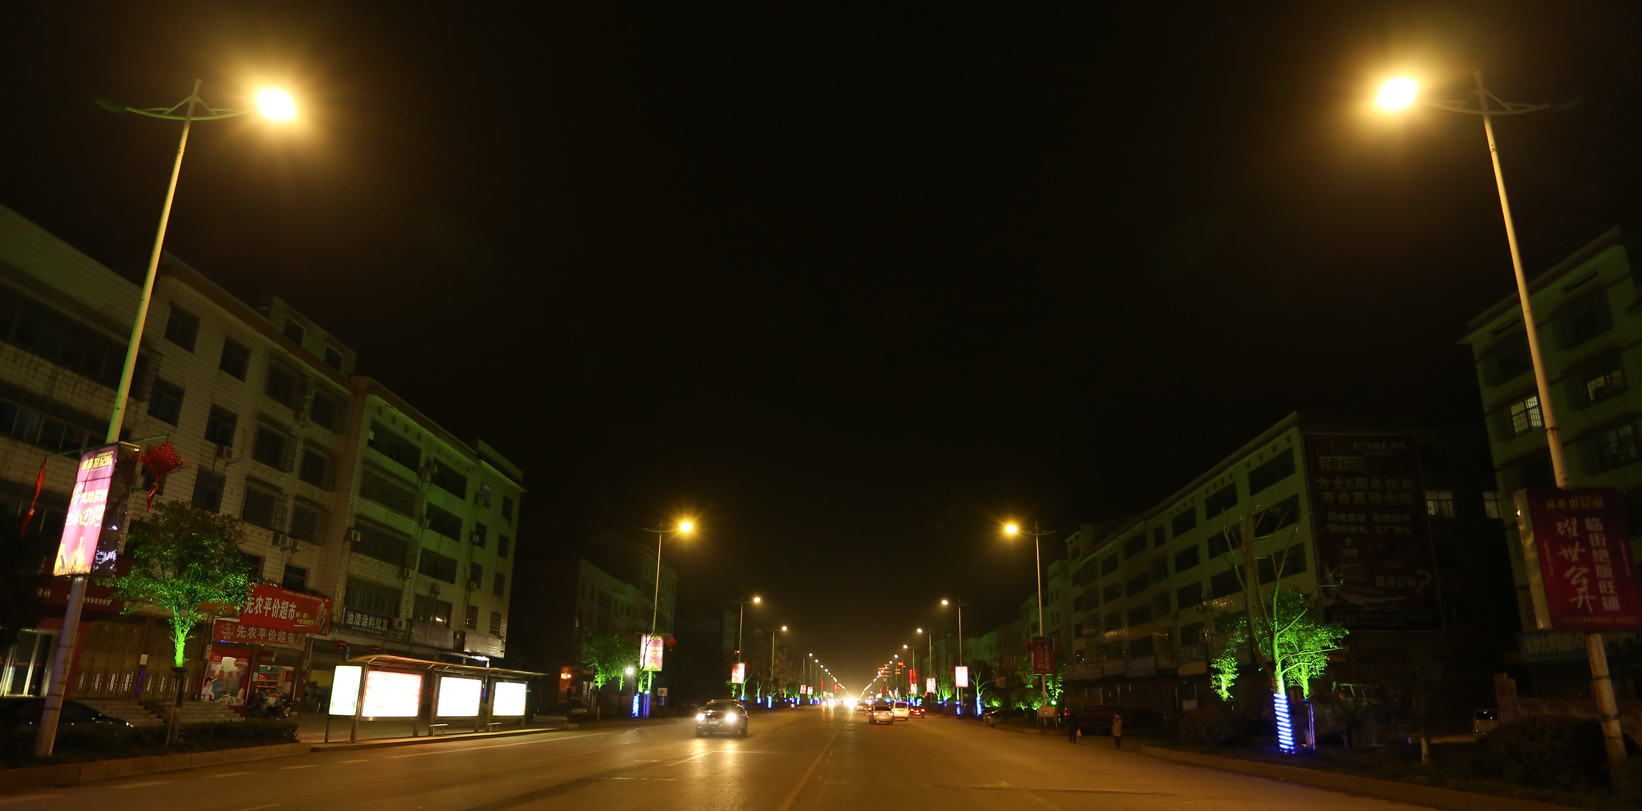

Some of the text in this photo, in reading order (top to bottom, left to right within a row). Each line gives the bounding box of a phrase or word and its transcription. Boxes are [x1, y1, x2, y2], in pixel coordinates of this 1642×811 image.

[1390, 441, 1408, 451] 方太
[1321, 458, 1364, 470] 7月19日
[1316, 477, 1415, 491] 方太6周年庆典
[1584, 517, 1620, 611] 临街绝版旺铺
[244, 595, 297, 620] 先农平价超市
[346, 611, 388, 632] 油漆涂料批发
[236, 625, 296, 644] 先农平价超市
